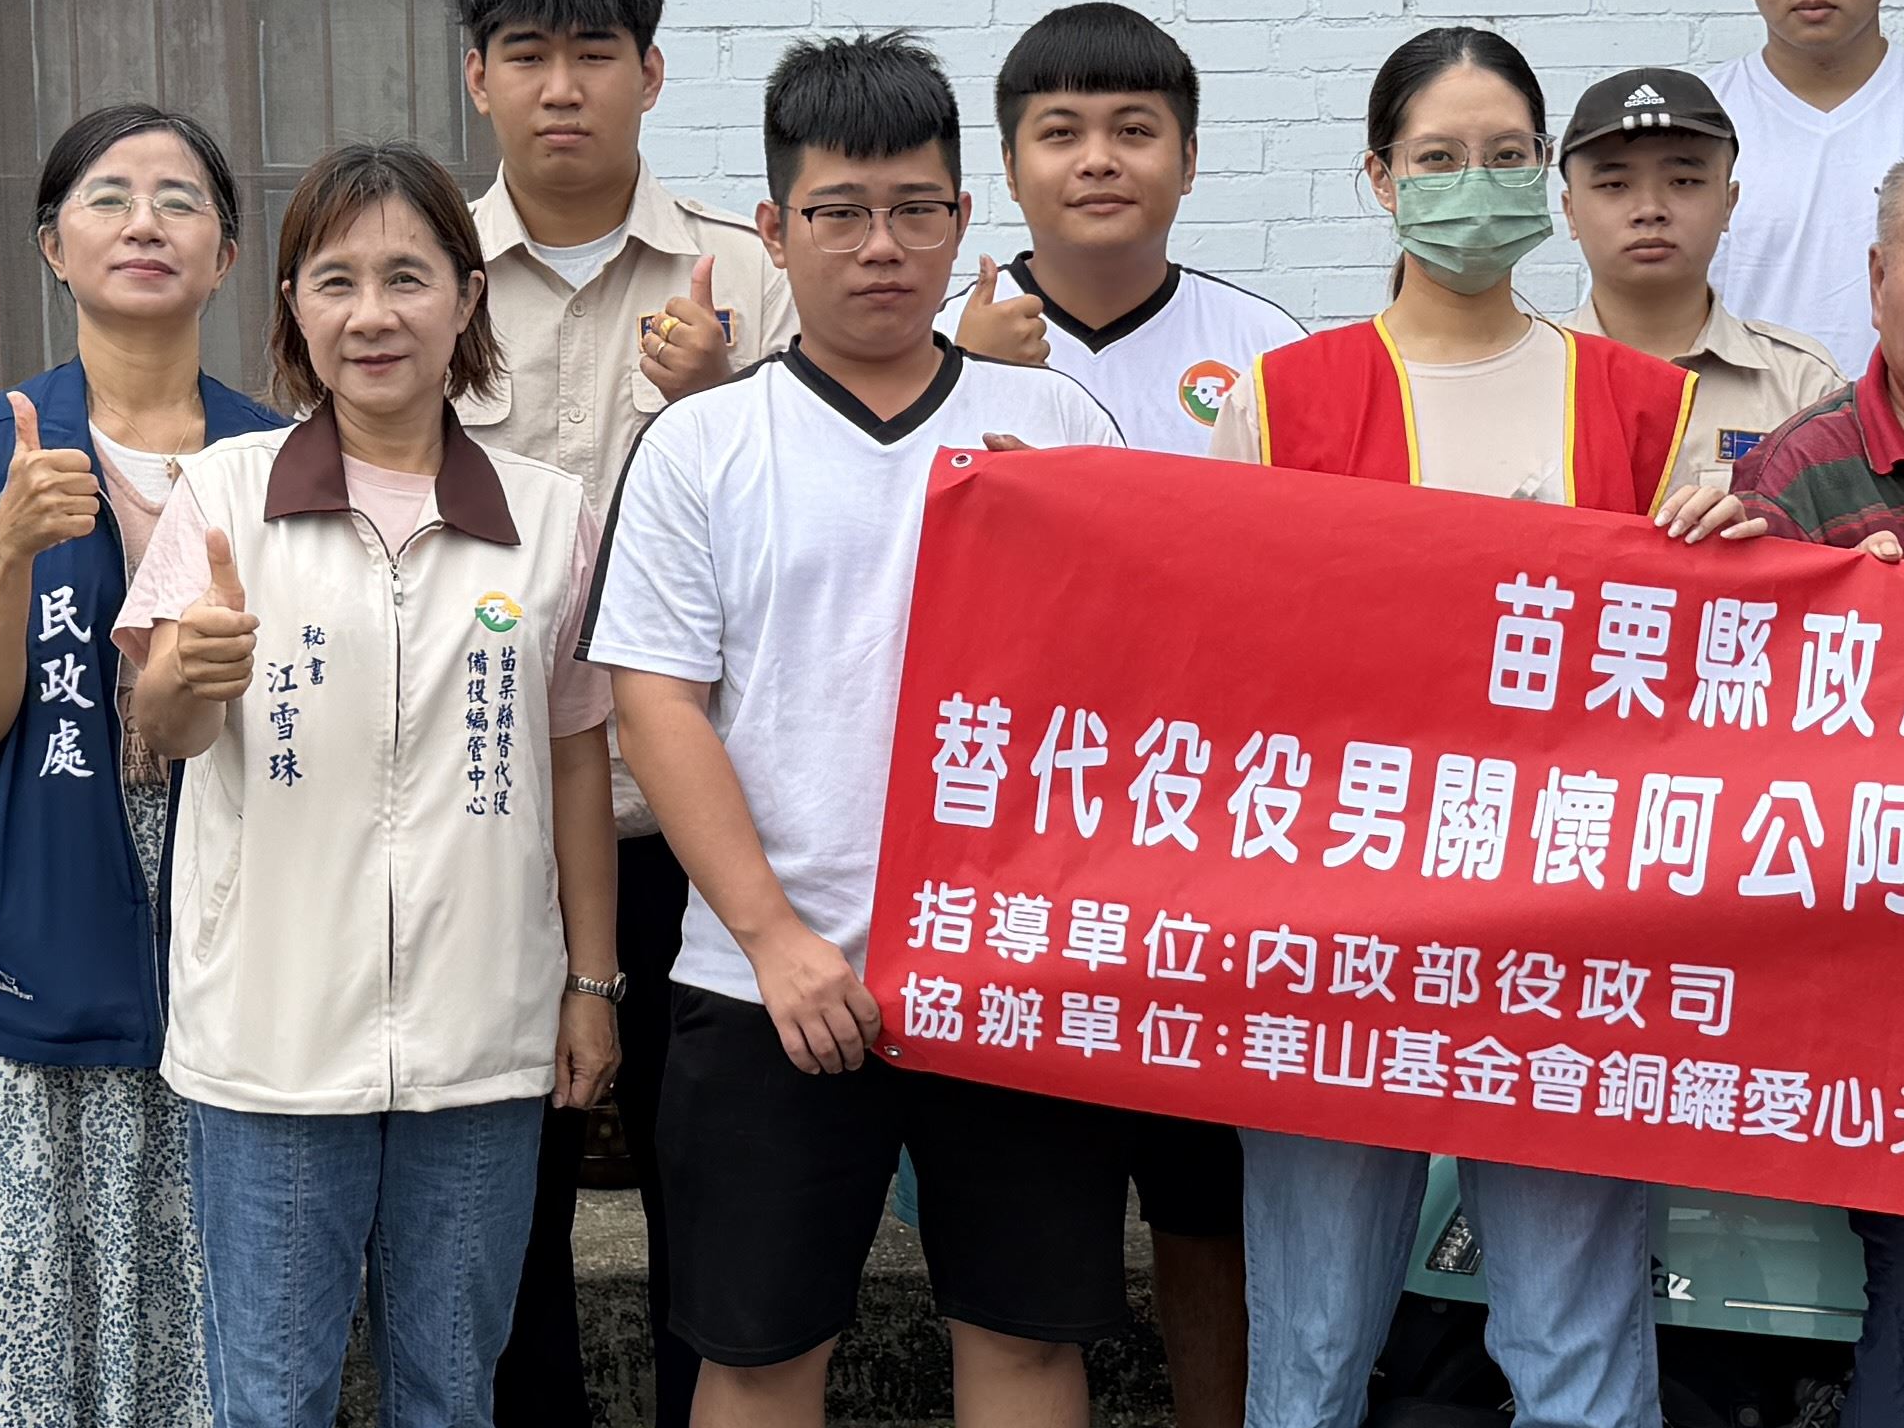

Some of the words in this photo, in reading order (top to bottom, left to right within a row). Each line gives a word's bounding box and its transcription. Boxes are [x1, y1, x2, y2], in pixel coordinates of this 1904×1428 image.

[1623, 97, 1666, 108] adidas
[39, 585, 95, 778] 民政處
[266, 662, 303, 789] 江雪珠
[302, 624, 326, 686] 秘書
[465, 651, 489, 816] 備役編管中心
[493, 646, 518, 816] 苗栗縣替代役
